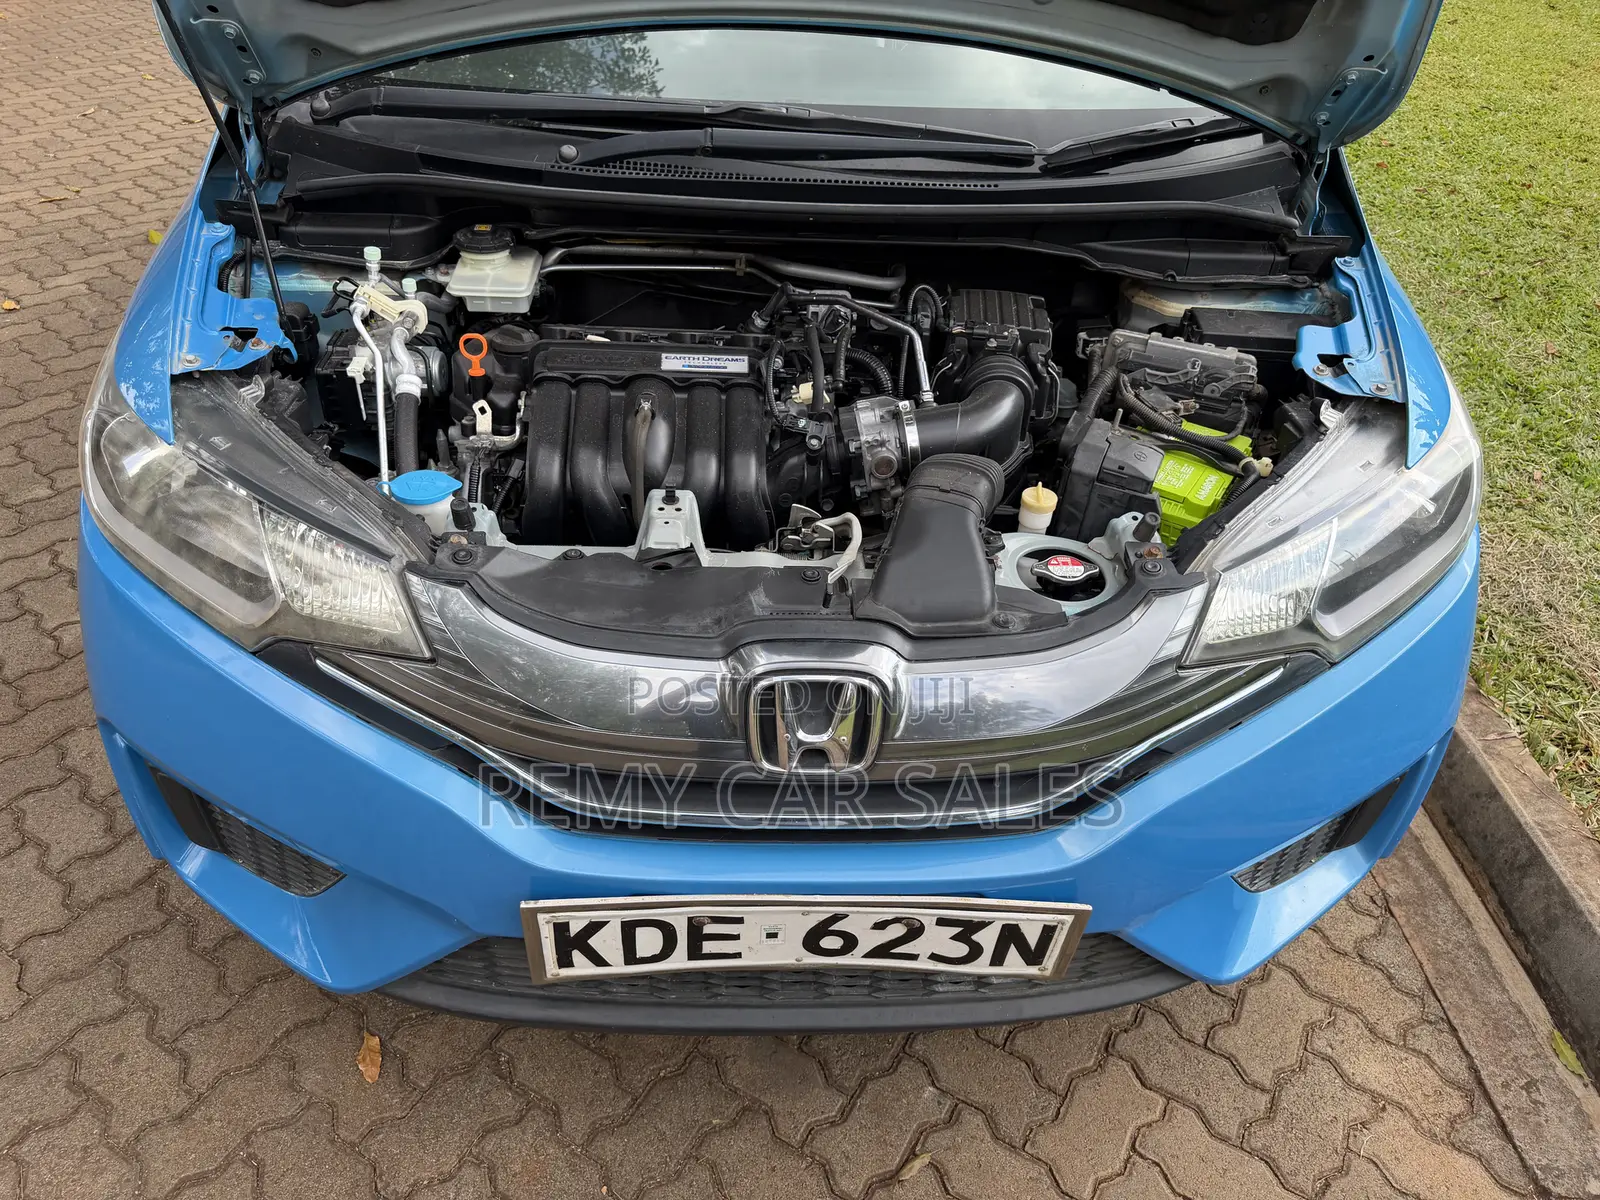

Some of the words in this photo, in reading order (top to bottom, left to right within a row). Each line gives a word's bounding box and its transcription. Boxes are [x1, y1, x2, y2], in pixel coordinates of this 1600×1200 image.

[702, 355, 746, 363] DREAMS
[552, 916, 745, 969] KDE
[802, 913, 1059, 967] 623N
